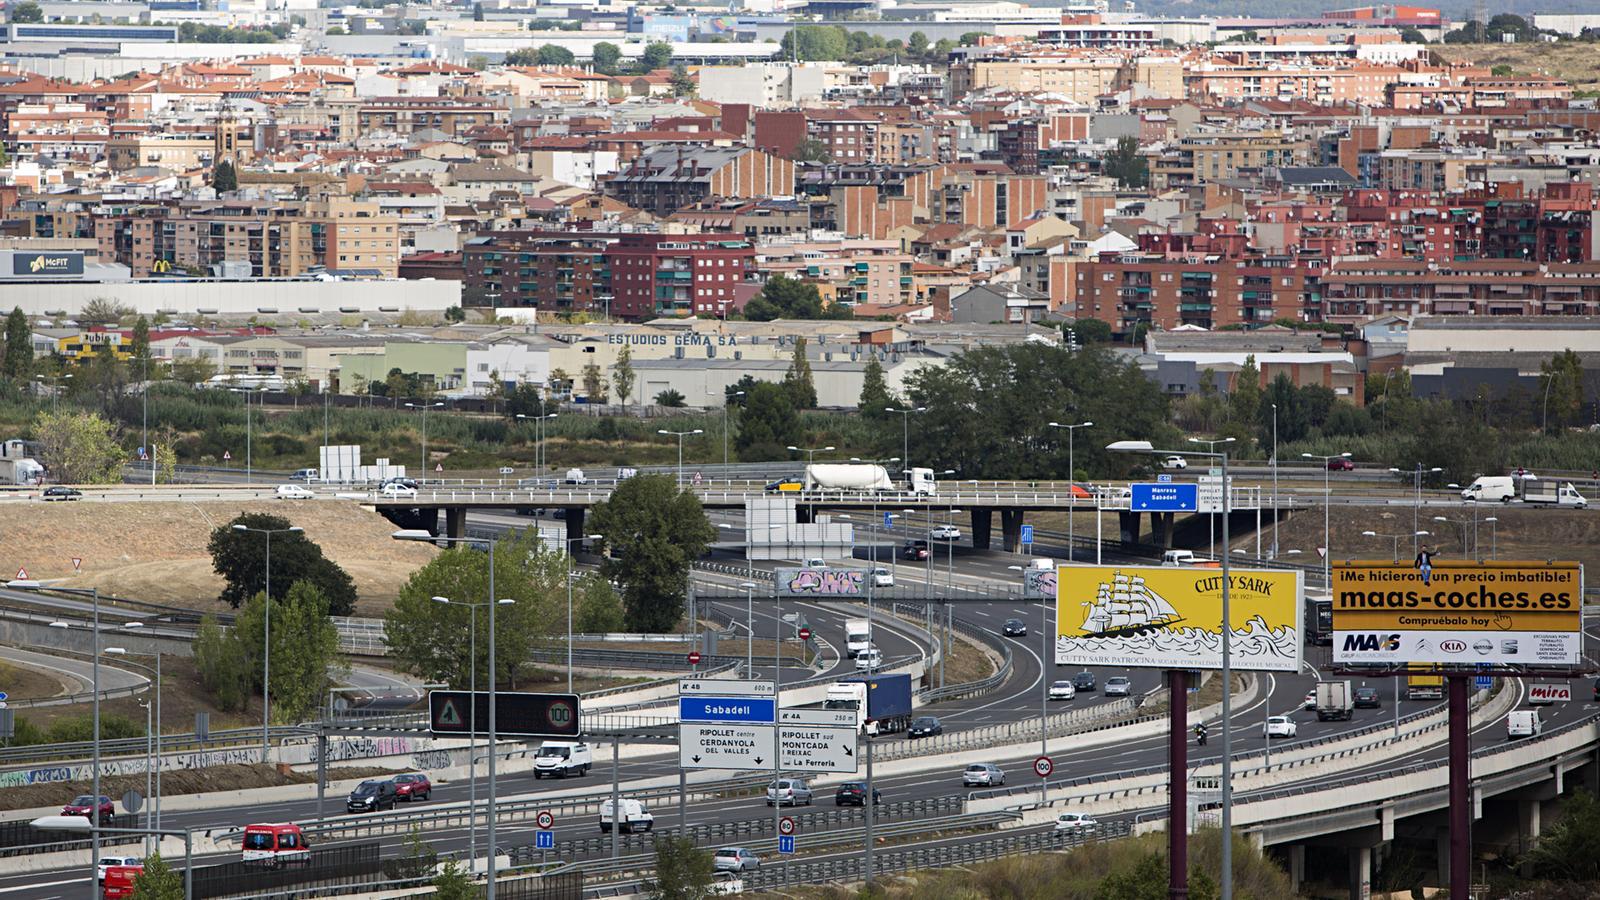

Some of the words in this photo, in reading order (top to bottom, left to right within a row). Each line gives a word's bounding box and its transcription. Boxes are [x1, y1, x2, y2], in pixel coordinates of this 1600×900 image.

[46, 258, 68, 266] McFIT
[608, 334, 666, 344] ESTUDIOS
[674, 335, 710, 346] GEMA
[1370, 571, 1424, 582] hicieron
[1432, 574, 1449, 582] un
[1454, 572, 1496, 584] precio
[1500, 572, 1570, 582] imbatible!
[1238, 576, 1276, 596] SARK
[1340, 585, 1572, 609] maas-coches.es
[1399, 615, 1468, 626] Compruébalo
[1471, 616, 1489, 626] hoy
[1531, 686, 1568, 698] mira
[552, 708, 568, 722] 100
[705, 704, 750, 714] Sabadell
[782, 732, 820, 740] RIPOLLET
[782, 742, 828, 750] MONTCADA
